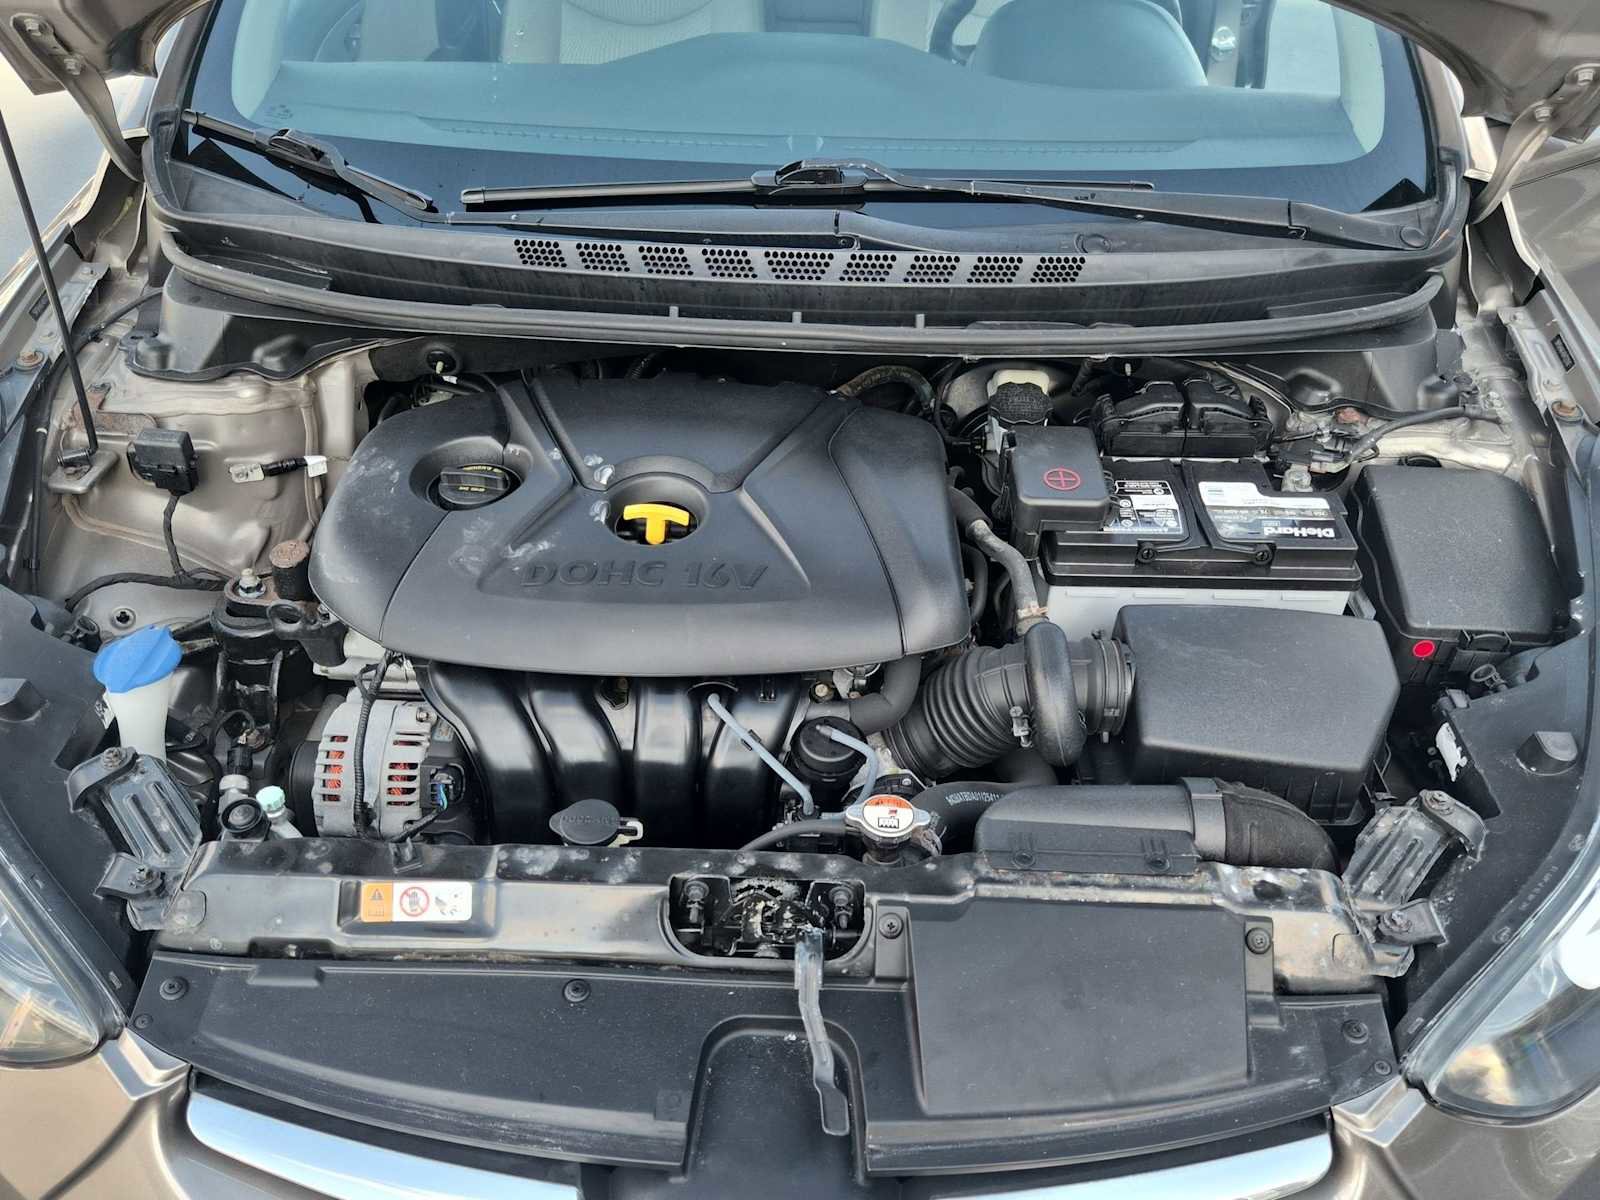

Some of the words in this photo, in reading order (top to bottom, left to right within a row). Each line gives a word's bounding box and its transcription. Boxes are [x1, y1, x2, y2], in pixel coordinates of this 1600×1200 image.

[1263, 526, 1336, 538] DieHard
[520, 559, 667, 588] DOHC
[682, 562, 769, 590] 16V
